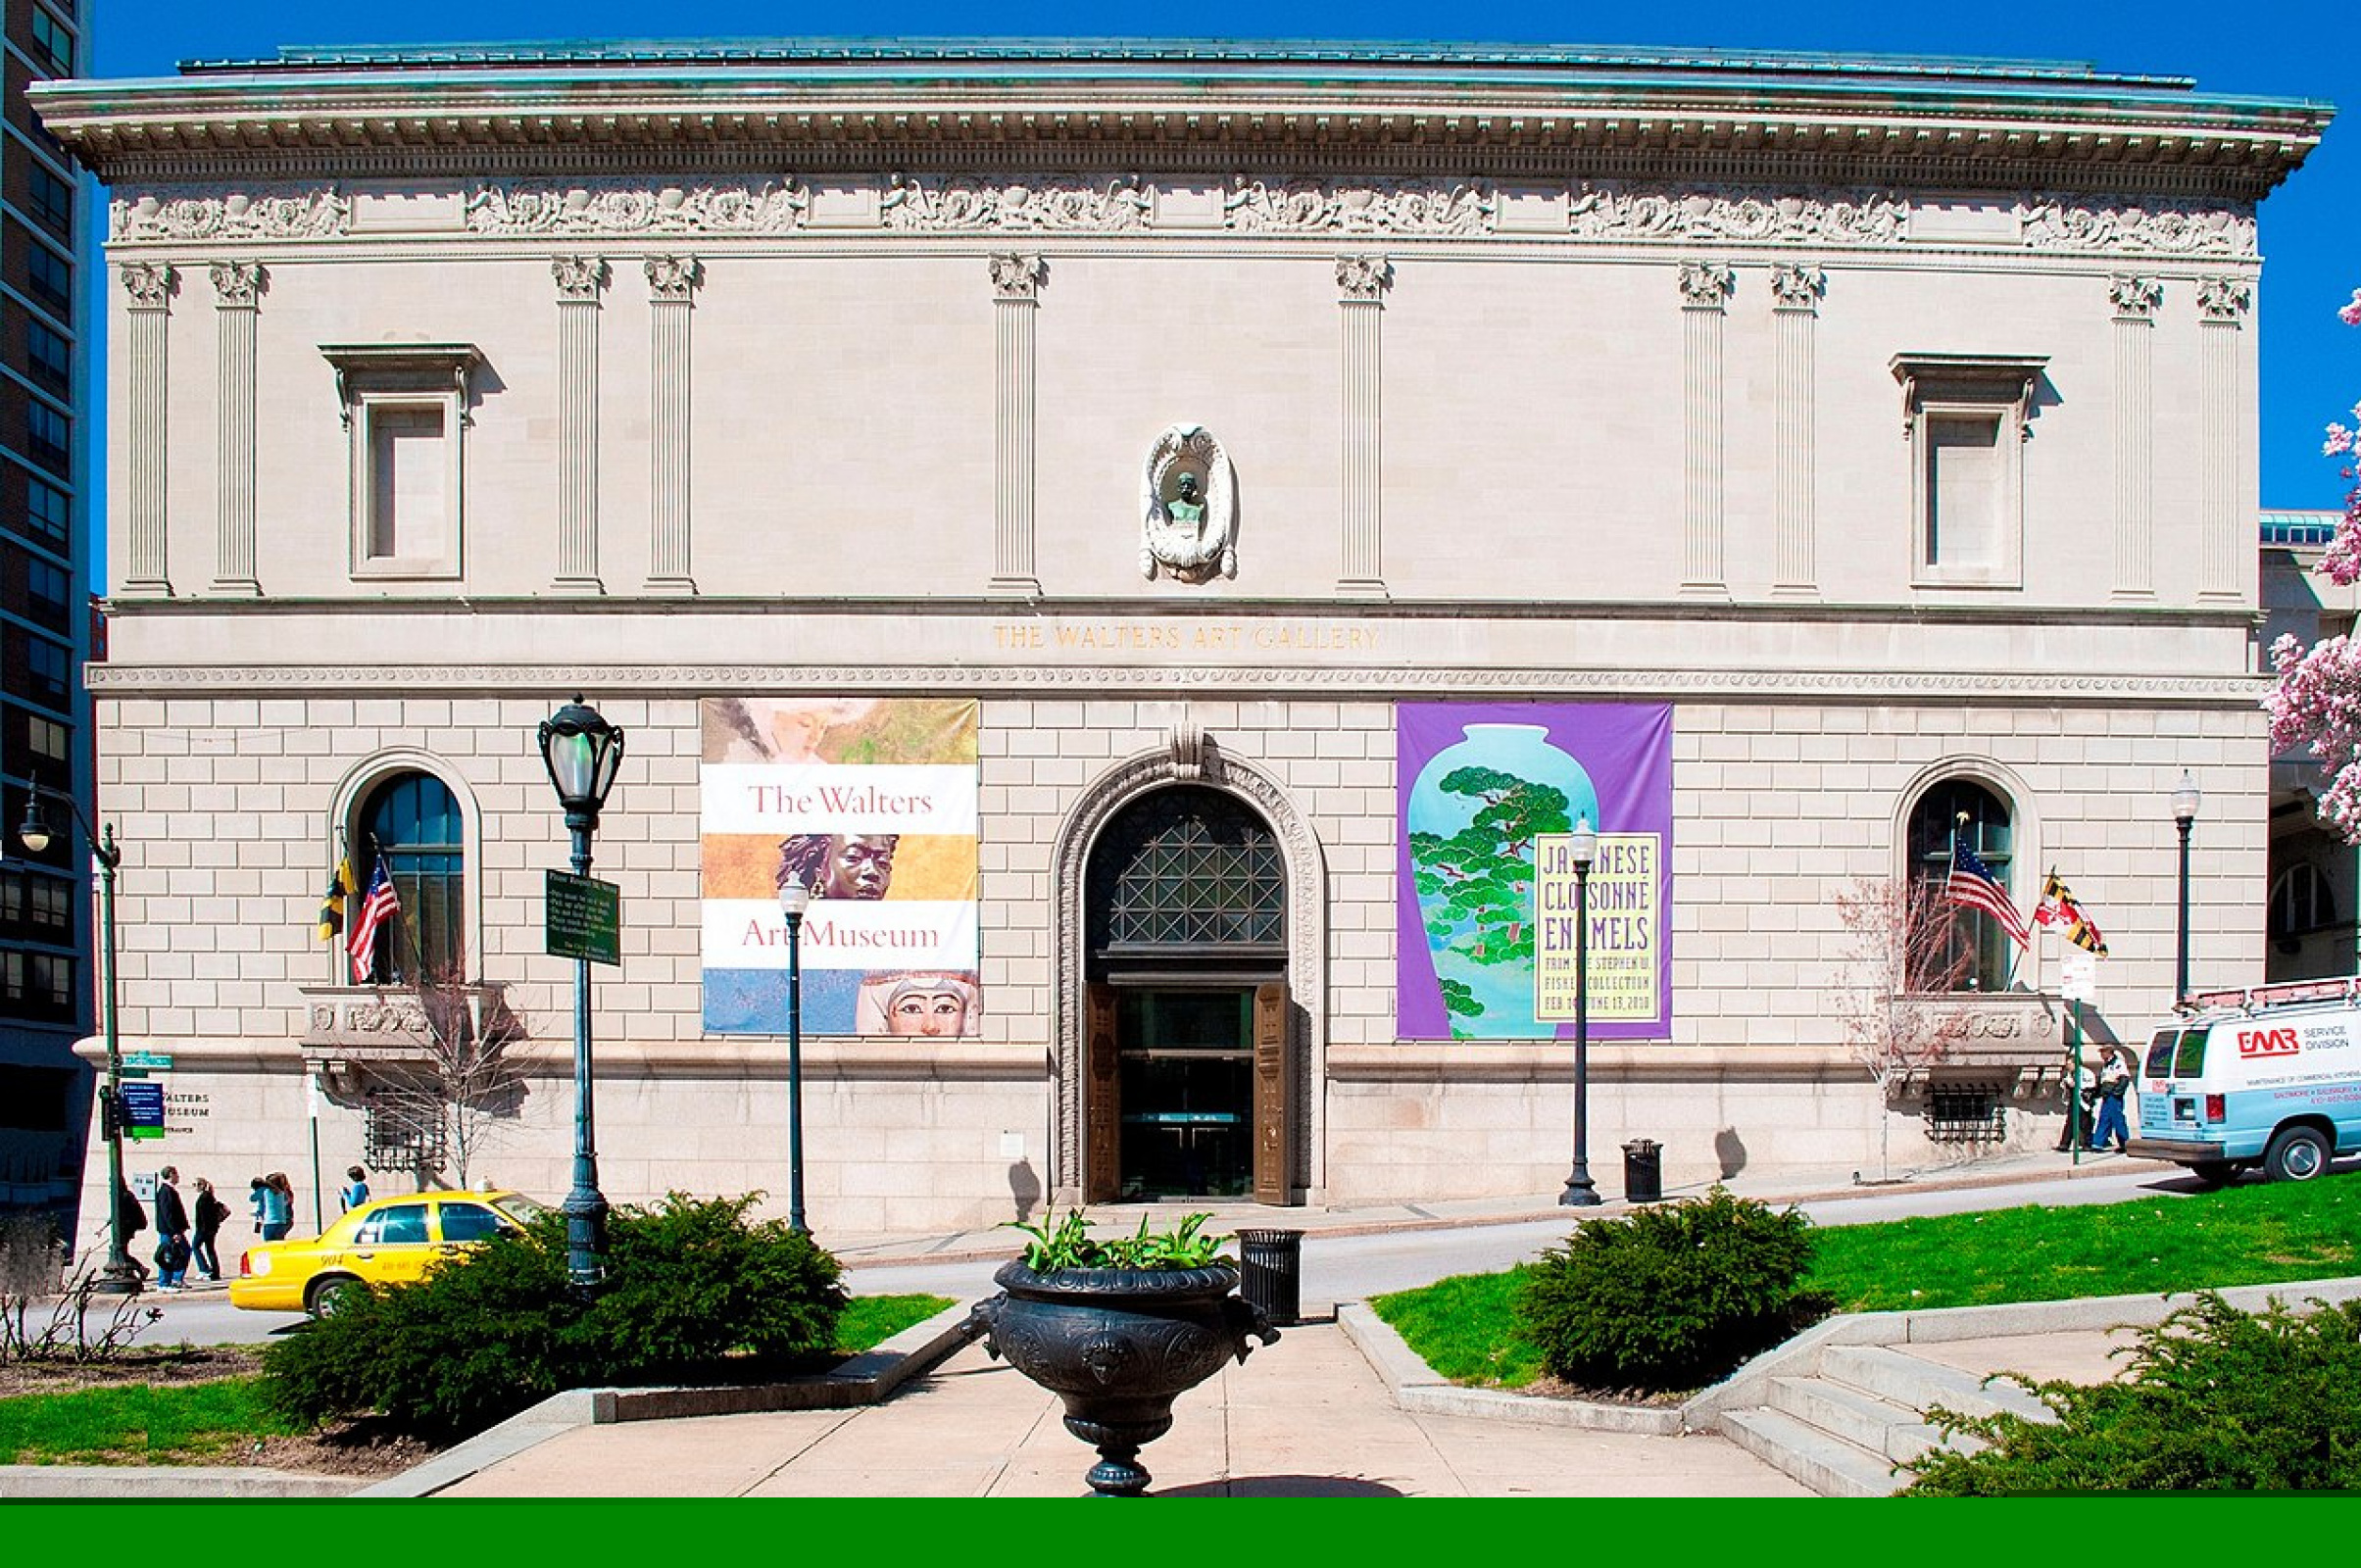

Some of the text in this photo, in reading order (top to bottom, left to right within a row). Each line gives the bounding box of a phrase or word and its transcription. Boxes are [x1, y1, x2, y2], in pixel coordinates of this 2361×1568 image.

[993, 625, 1380, 650] THE WALTERS ART GALLERY
[747, 785, 933, 814] The Walters
[1543, 845, 1649, 874] JANESE
[1545, 876, 1649, 910] CLOSONNÉ
[742, 919, 939, 948] Art Museum
[1545, 916, 1648, 951] ENMELS
[1545, 956, 1570, 970] FROM
[1596, 956, 1638, 970] STEPHEN
[1545, 975, 1649, 990] FISHE COLLECTION
[2237, 1025, 2347, 1054] EMR SERVICE
[2304, 1038, 2349, 1051] DIVISION
[163, 1107, 209, 1116] USEUM
